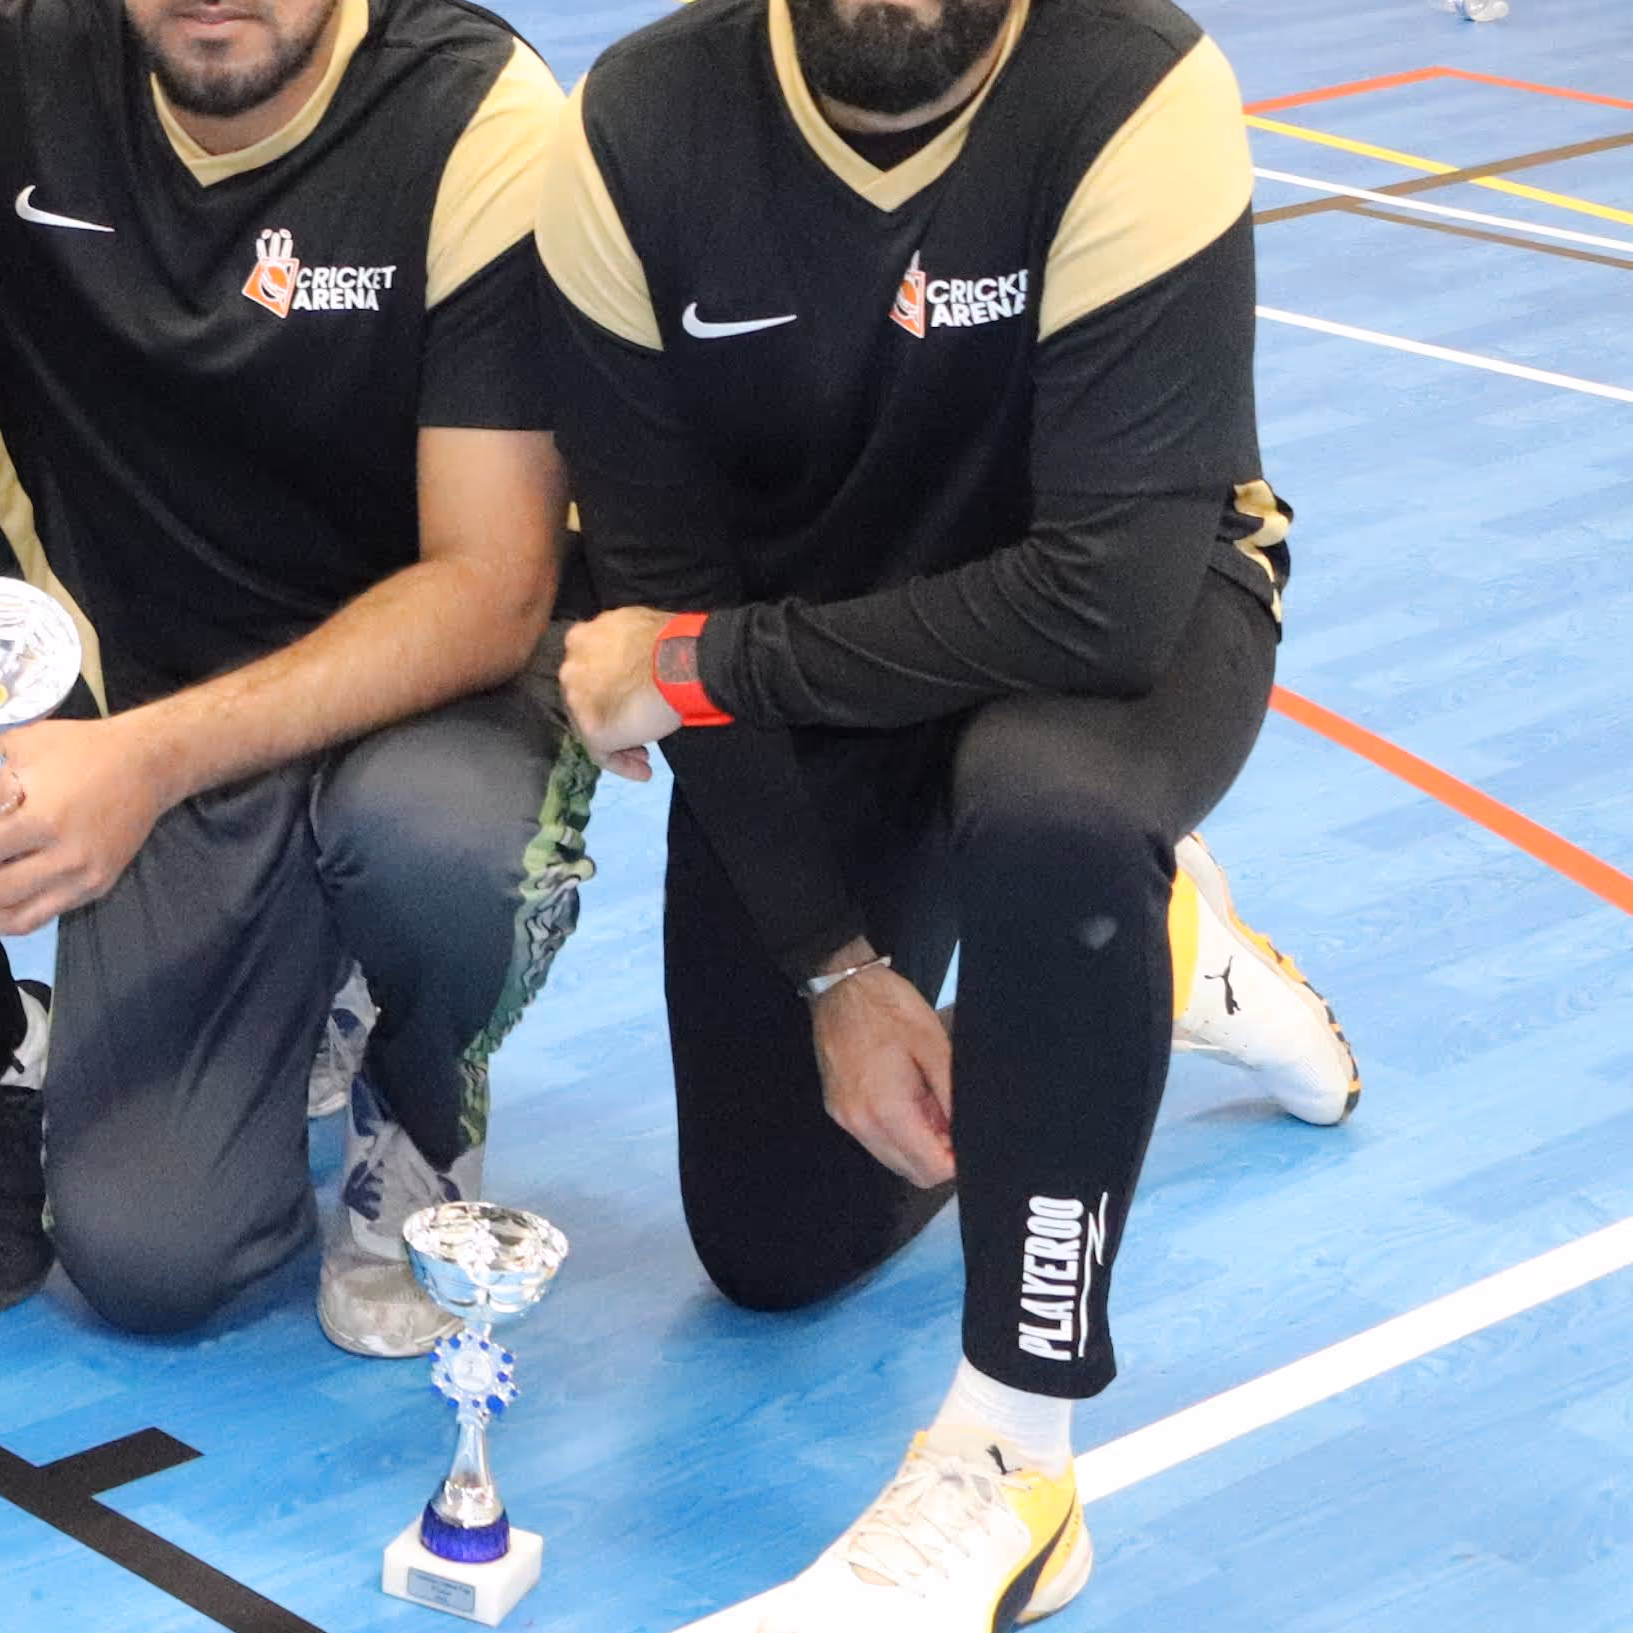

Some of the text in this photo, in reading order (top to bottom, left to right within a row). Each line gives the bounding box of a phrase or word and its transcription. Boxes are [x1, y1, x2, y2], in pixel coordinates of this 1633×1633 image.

[295, 265, 397, 290] CRICKET
[926, 269, 1029, 305] CRICK
[291, 288, 380, 311] ARENA
[1017, 1195, 1085, 1361] PLAYEROO
